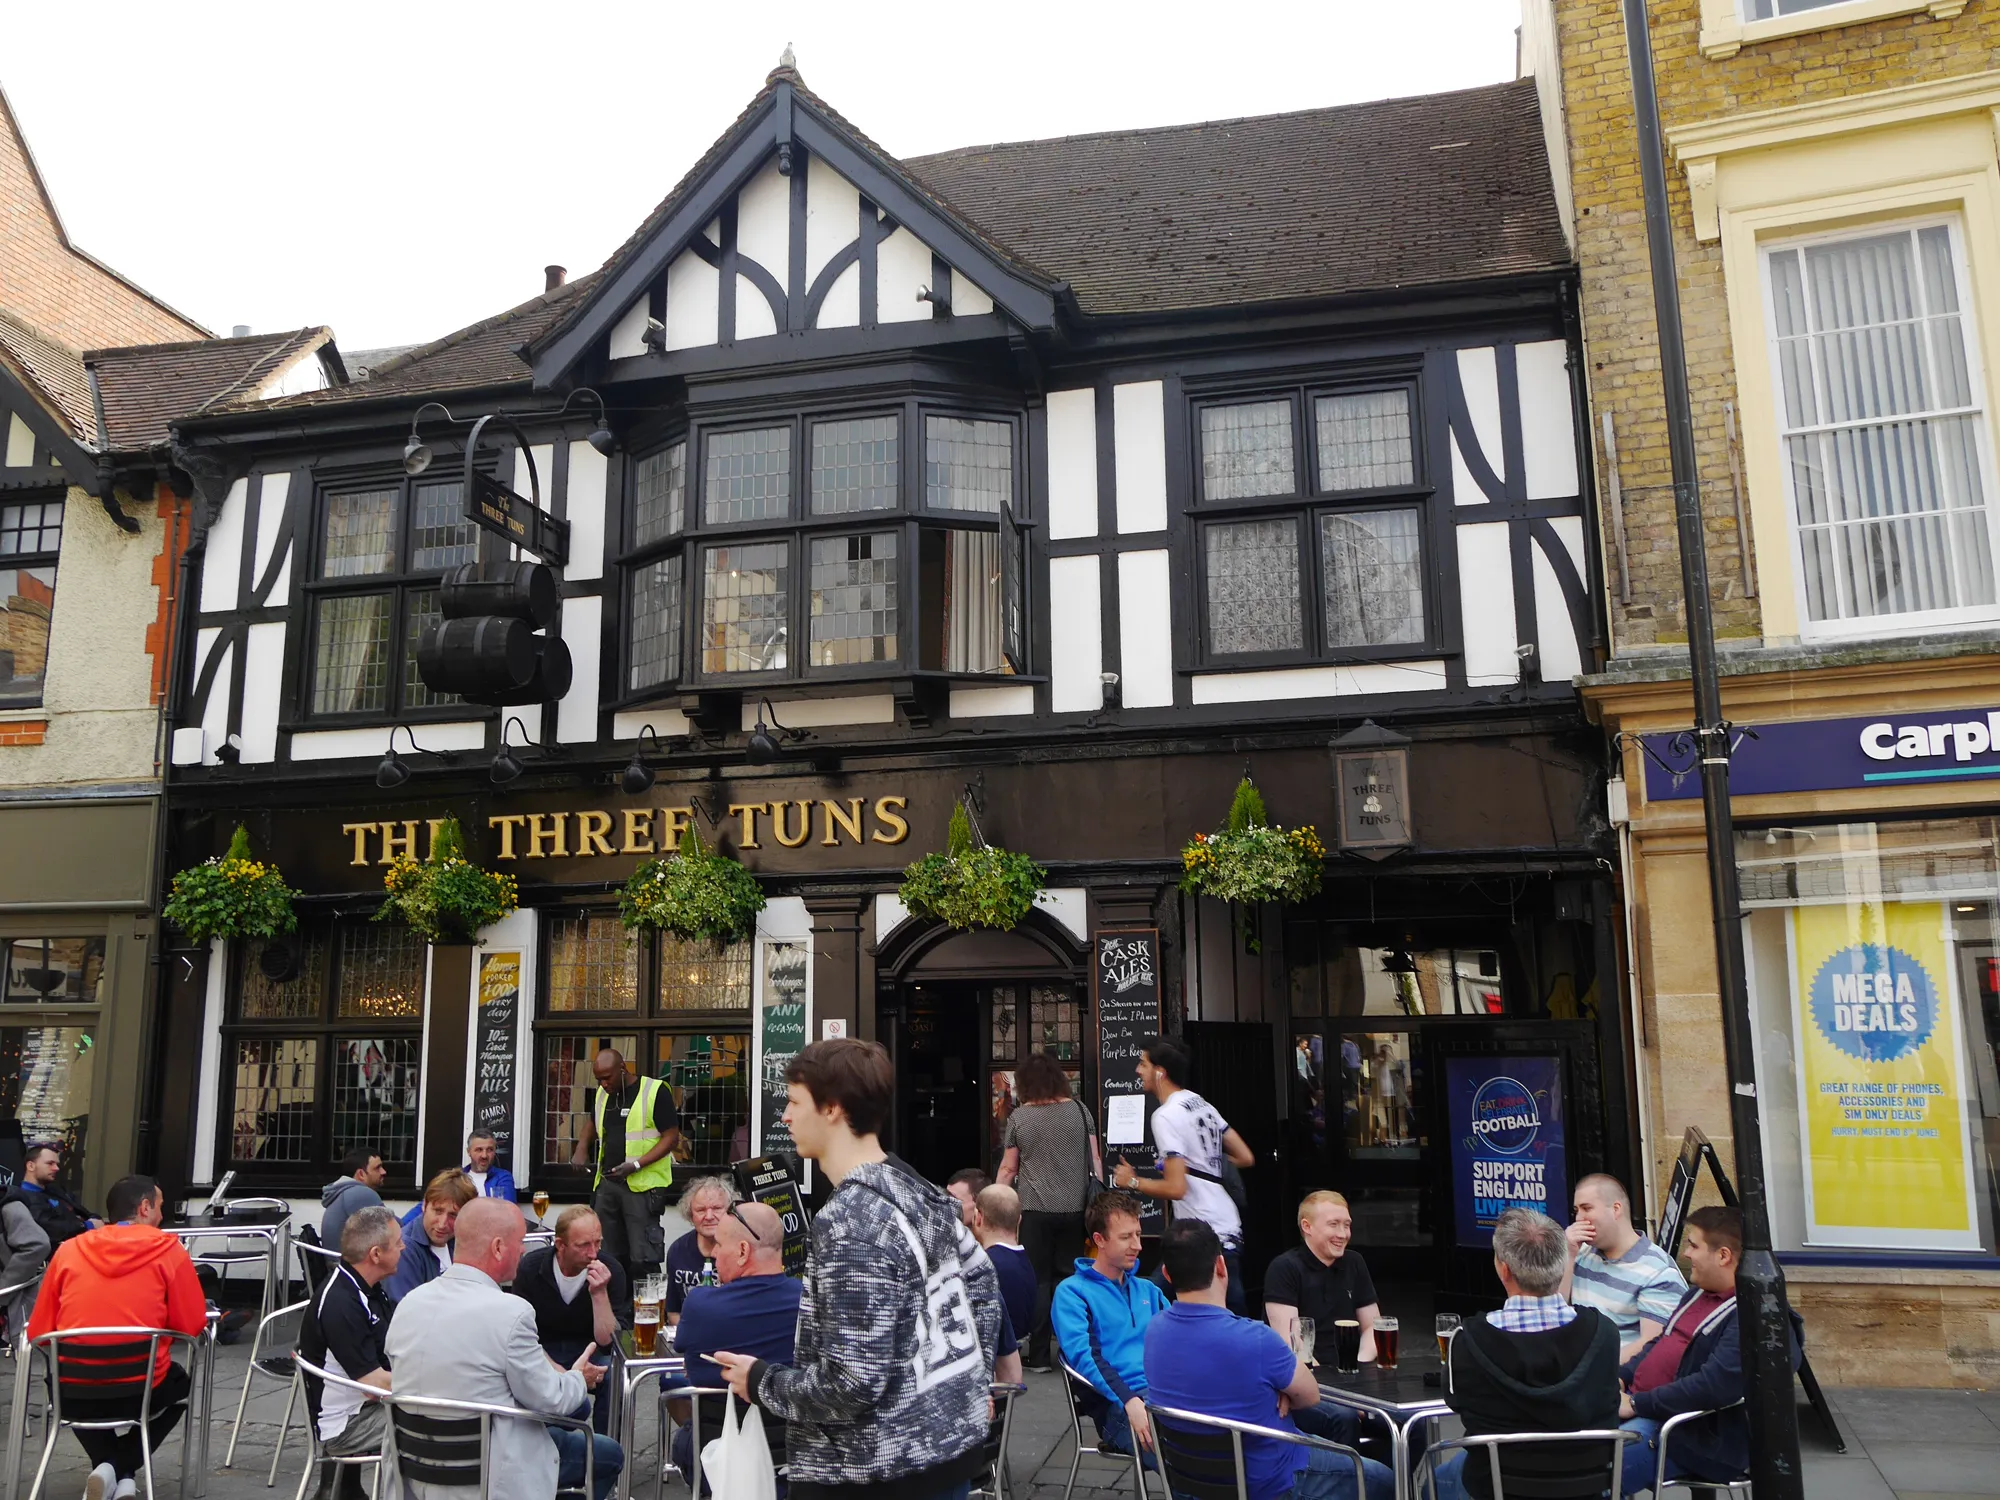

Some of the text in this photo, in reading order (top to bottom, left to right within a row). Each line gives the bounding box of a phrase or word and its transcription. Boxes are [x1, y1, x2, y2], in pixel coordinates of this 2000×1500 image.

[481, 501, 525, 536] THREE TUNS
[1352, 784, 1394, 796] THREE
[1359, 814, 1391, 825] TUNS
[488, 807, 695, 861] THREE
[728, 796, 909, 850] TUNS
[1100, 940, 1151, 968] CASK
[485, 973, 514, 983] COOKED
[1103, 956, 1151, 984] ALES
[484, 983, 517, 998] FOOD
[1832, 973, 1916, 1003] MEGA
[770, 1003, 802, 1017] ANY
[1834, 1004, 1918, 1032] DEALS
[767, 1022, 804, 1034] OCCASION
[1102, 1041, 1128, 1060] Purple
[480, 1062, 511, 1078] REAL
[480, 1079, 511, 1093] ALES
[1820, 1083, 1944, 1095] GREAT RANGE OF PHONES,
[1838, 1096, 1926, 1107] ACCESSORIES AND
[480, 1103, 507, 1121] CAMRA
[1844, 1109, 1922, 1120] SIM ONLY DEALS
[1472, 1113, 1541, 1134] FOOTBALL
[1861, 1127, 1883, 1136] MUST
[1885, 1127, 1901, 1136] END
[1916, 1127, 1939, 1137] JUNE!
[762, 1161, 774, 1171] THE
[1473, 1161, 1545, 1181] SUPPORT
[752, 1168, 788, 1186] THREE TUNS
[1473, 1179, 1547, 1200] ENGLAND
[1474, 1198, 1506, 1215] LIVE
